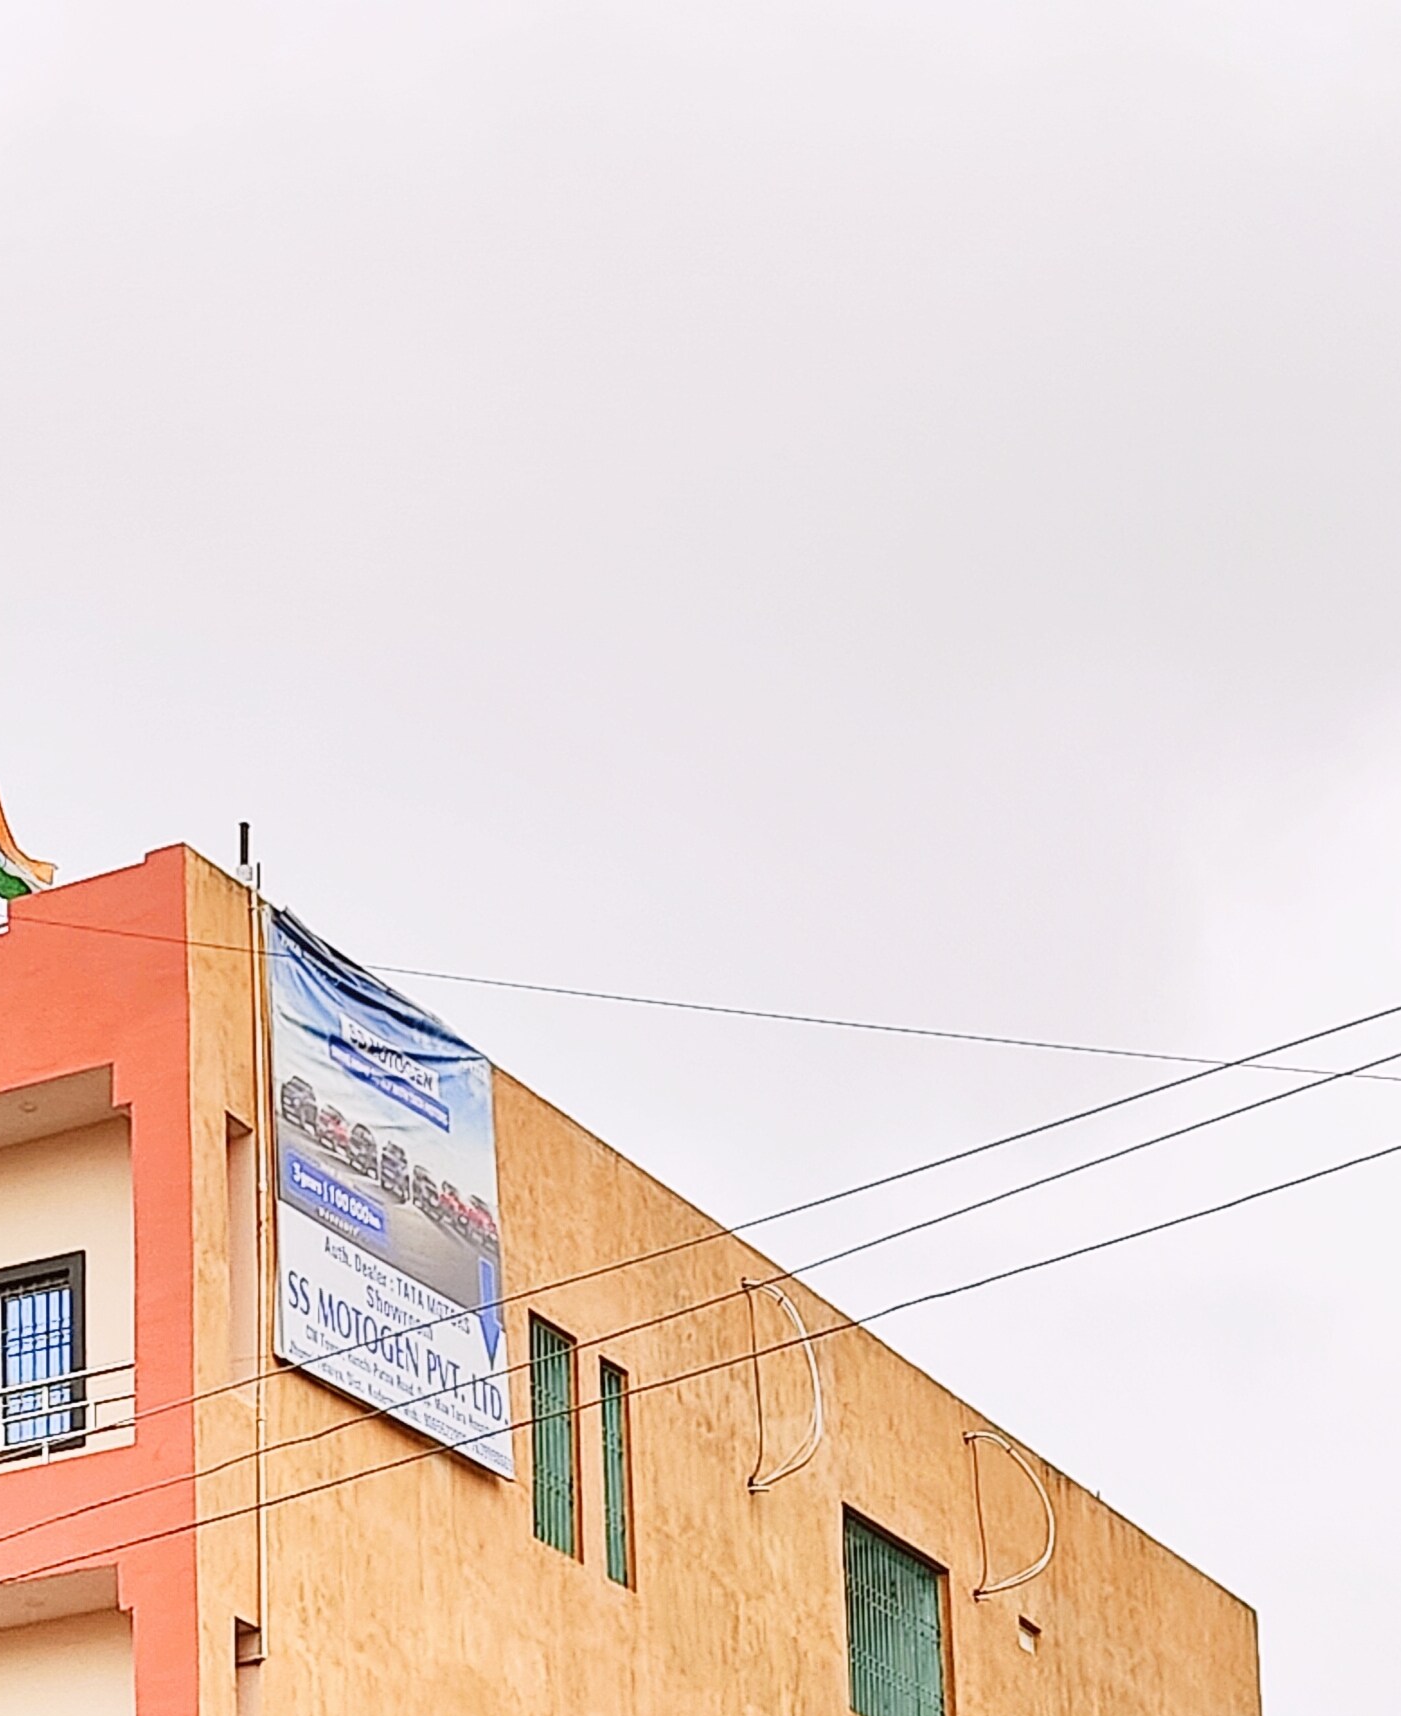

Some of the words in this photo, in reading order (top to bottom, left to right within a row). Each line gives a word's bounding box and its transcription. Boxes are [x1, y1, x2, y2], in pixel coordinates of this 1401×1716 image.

[288, 1270, 311, 1316] SS
[318, 1287, 420, 1379] MOTOGEN
[427, 1349, 467, 1403] PVT.
[472, 1371, 510, 1426] LTD.
